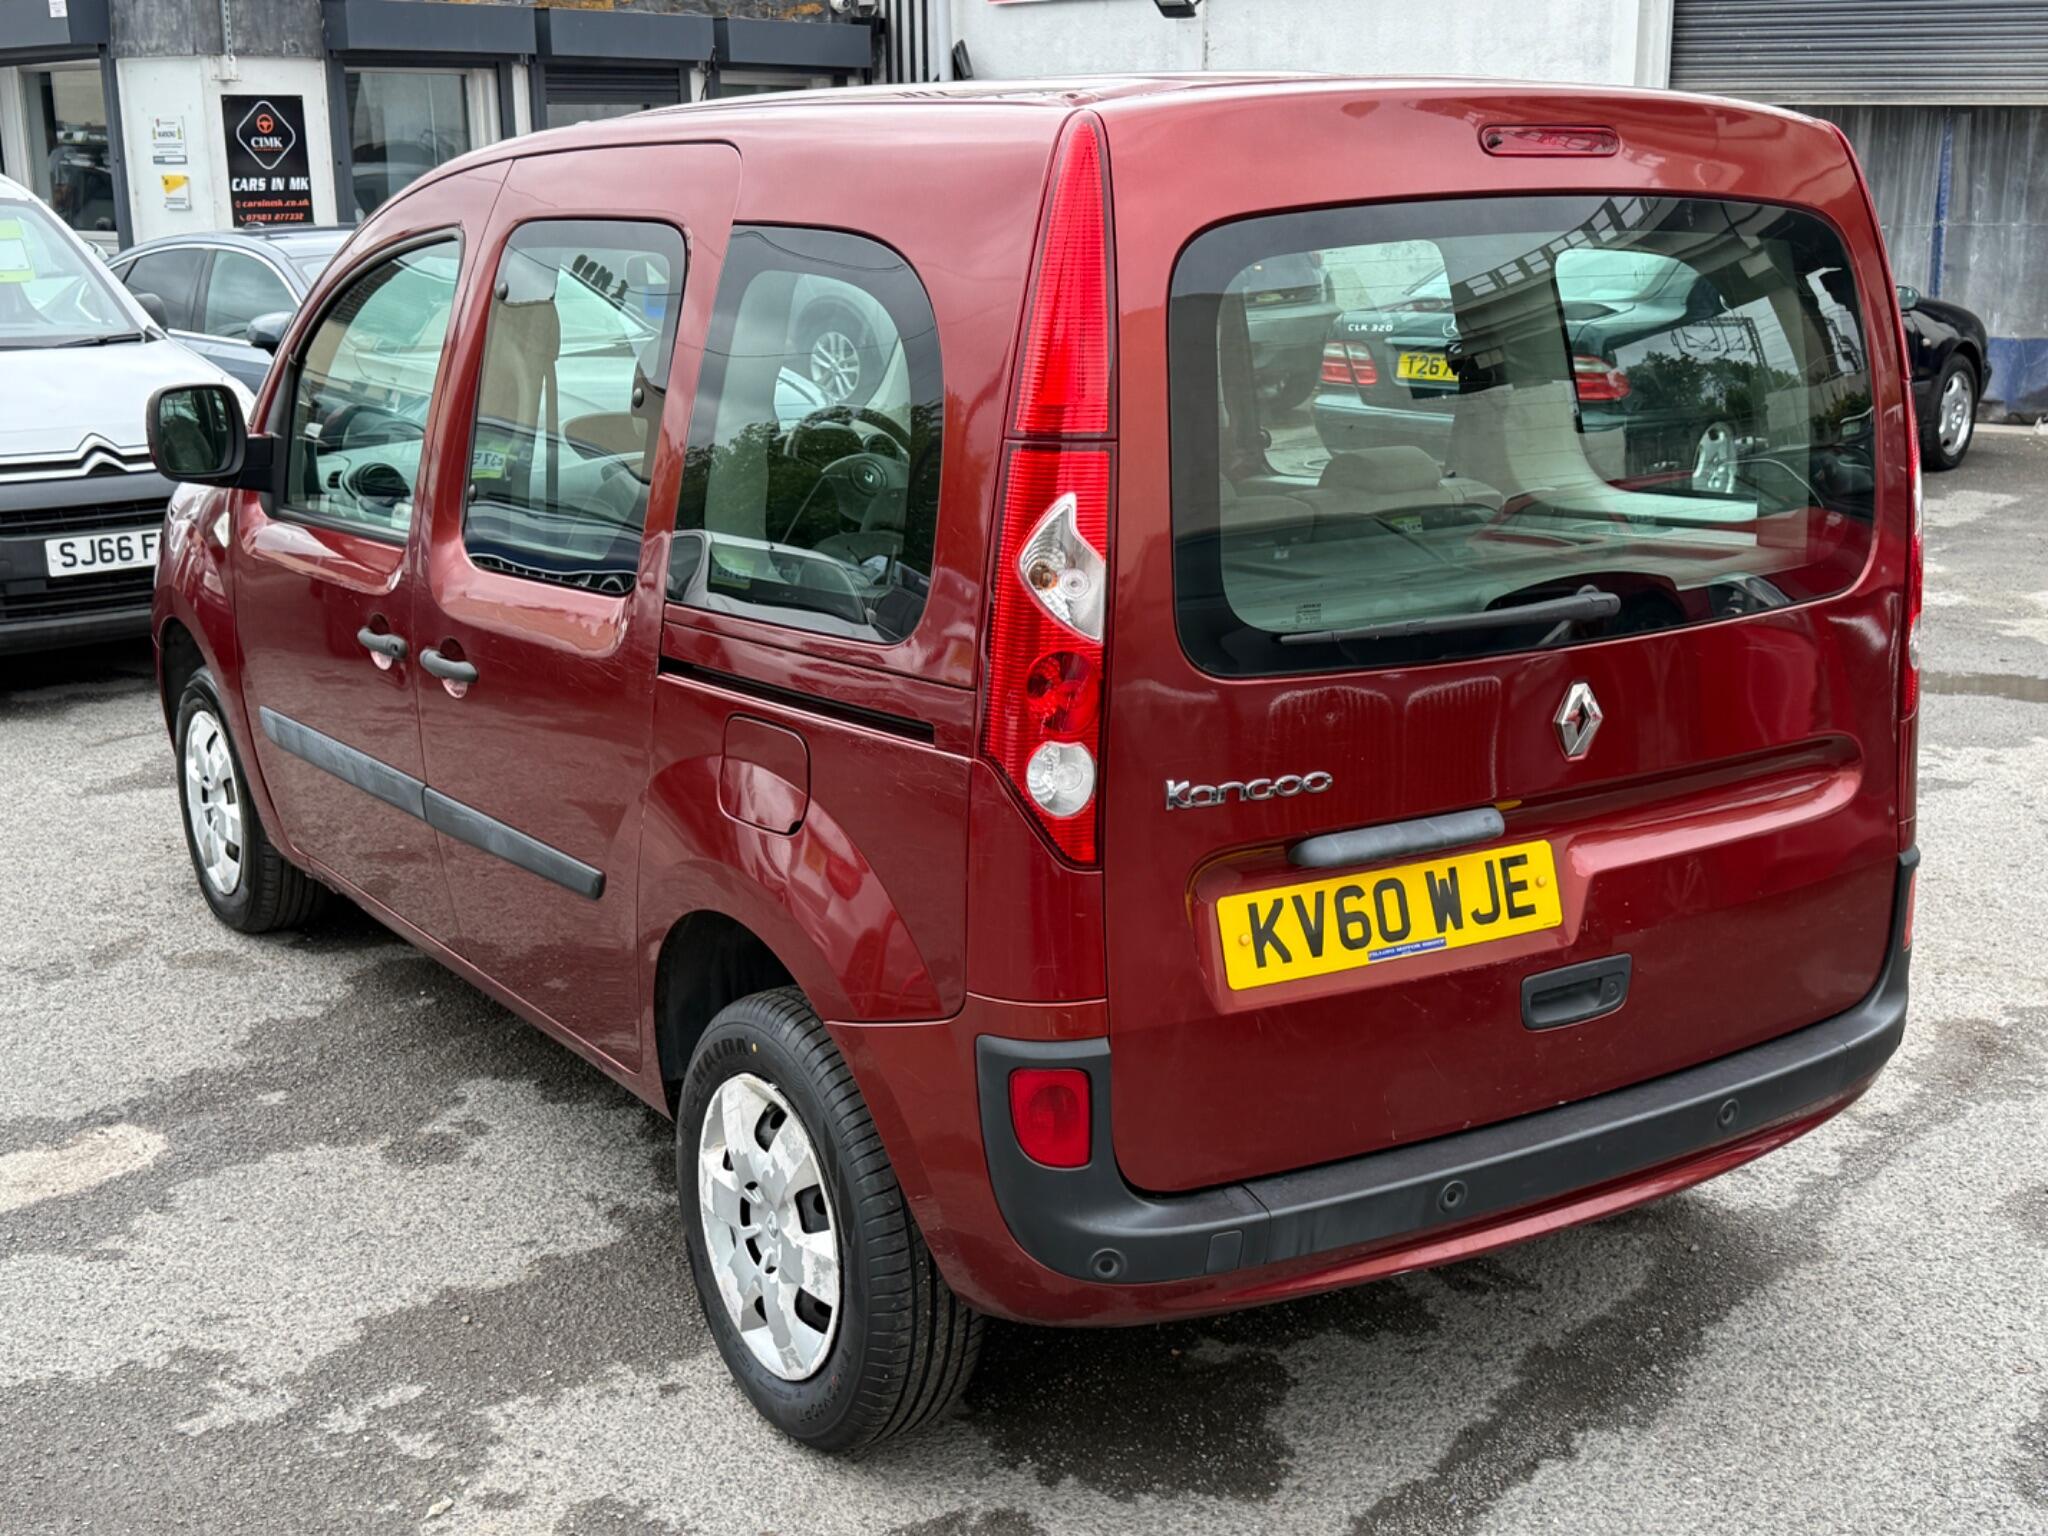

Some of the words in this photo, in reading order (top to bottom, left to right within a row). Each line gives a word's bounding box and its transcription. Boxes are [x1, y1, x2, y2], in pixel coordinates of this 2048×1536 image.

[250, 136, 283, 148] CIMK
[232, 178, 266, 191] CARS
[271, 177, 285, 191] IN
[289, 176, 309, 190] MK
[1348, 324, 1368, 332] CLK
[1371, 324, 1394, 332] 320
[59, 536, 134, 568] SJ66
[1247, 878, 1411, 968] KV60
[1424, 854, 1536, 933] WJE
